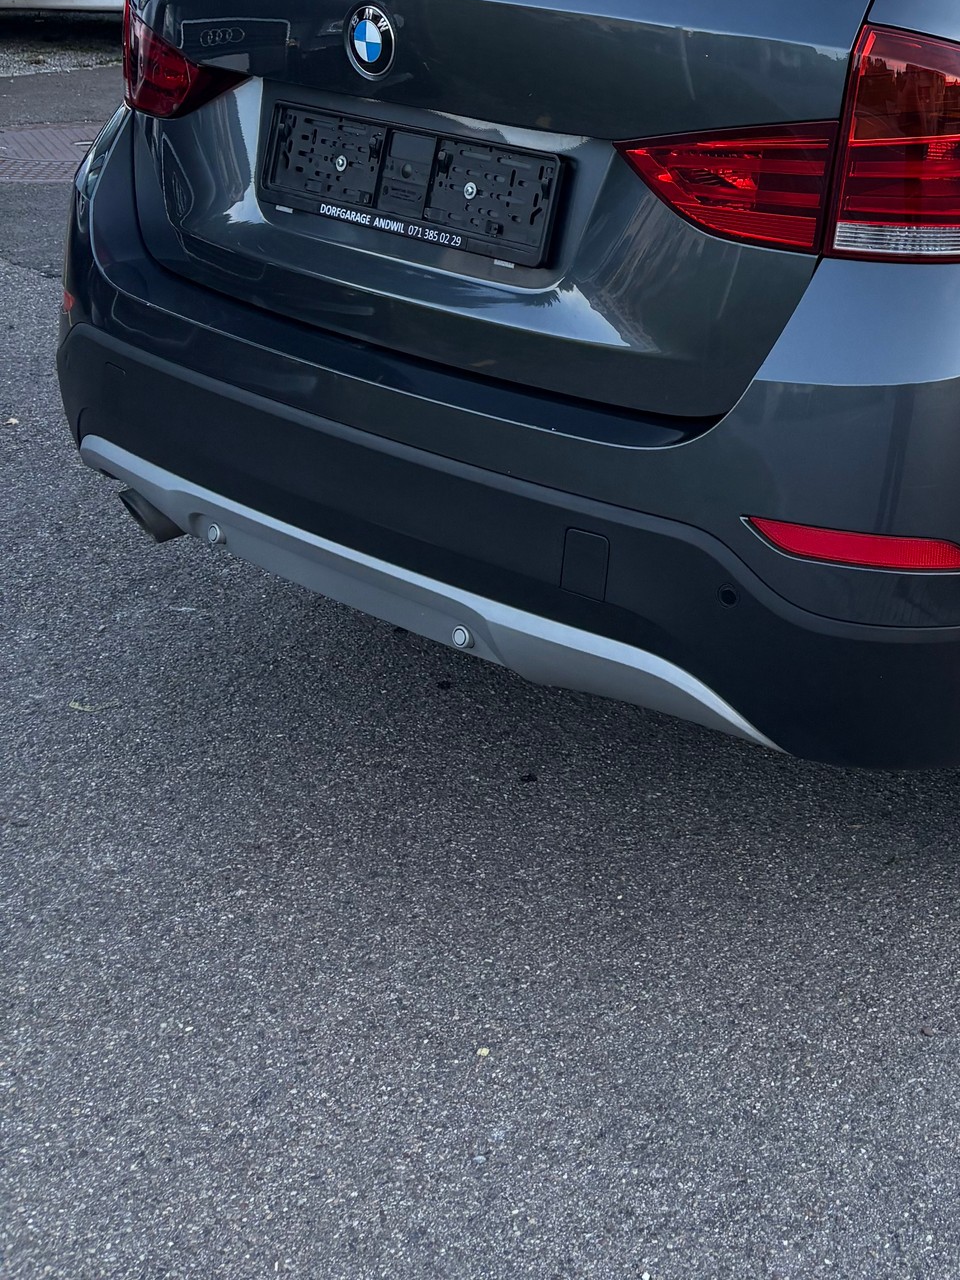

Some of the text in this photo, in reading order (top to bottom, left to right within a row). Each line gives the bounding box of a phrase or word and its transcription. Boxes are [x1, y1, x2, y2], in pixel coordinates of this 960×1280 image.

[351, 8, 389, 32] BMW
[320, 204, 462, 247] DORFGARAGE ANDWIL 071 385 02 29
